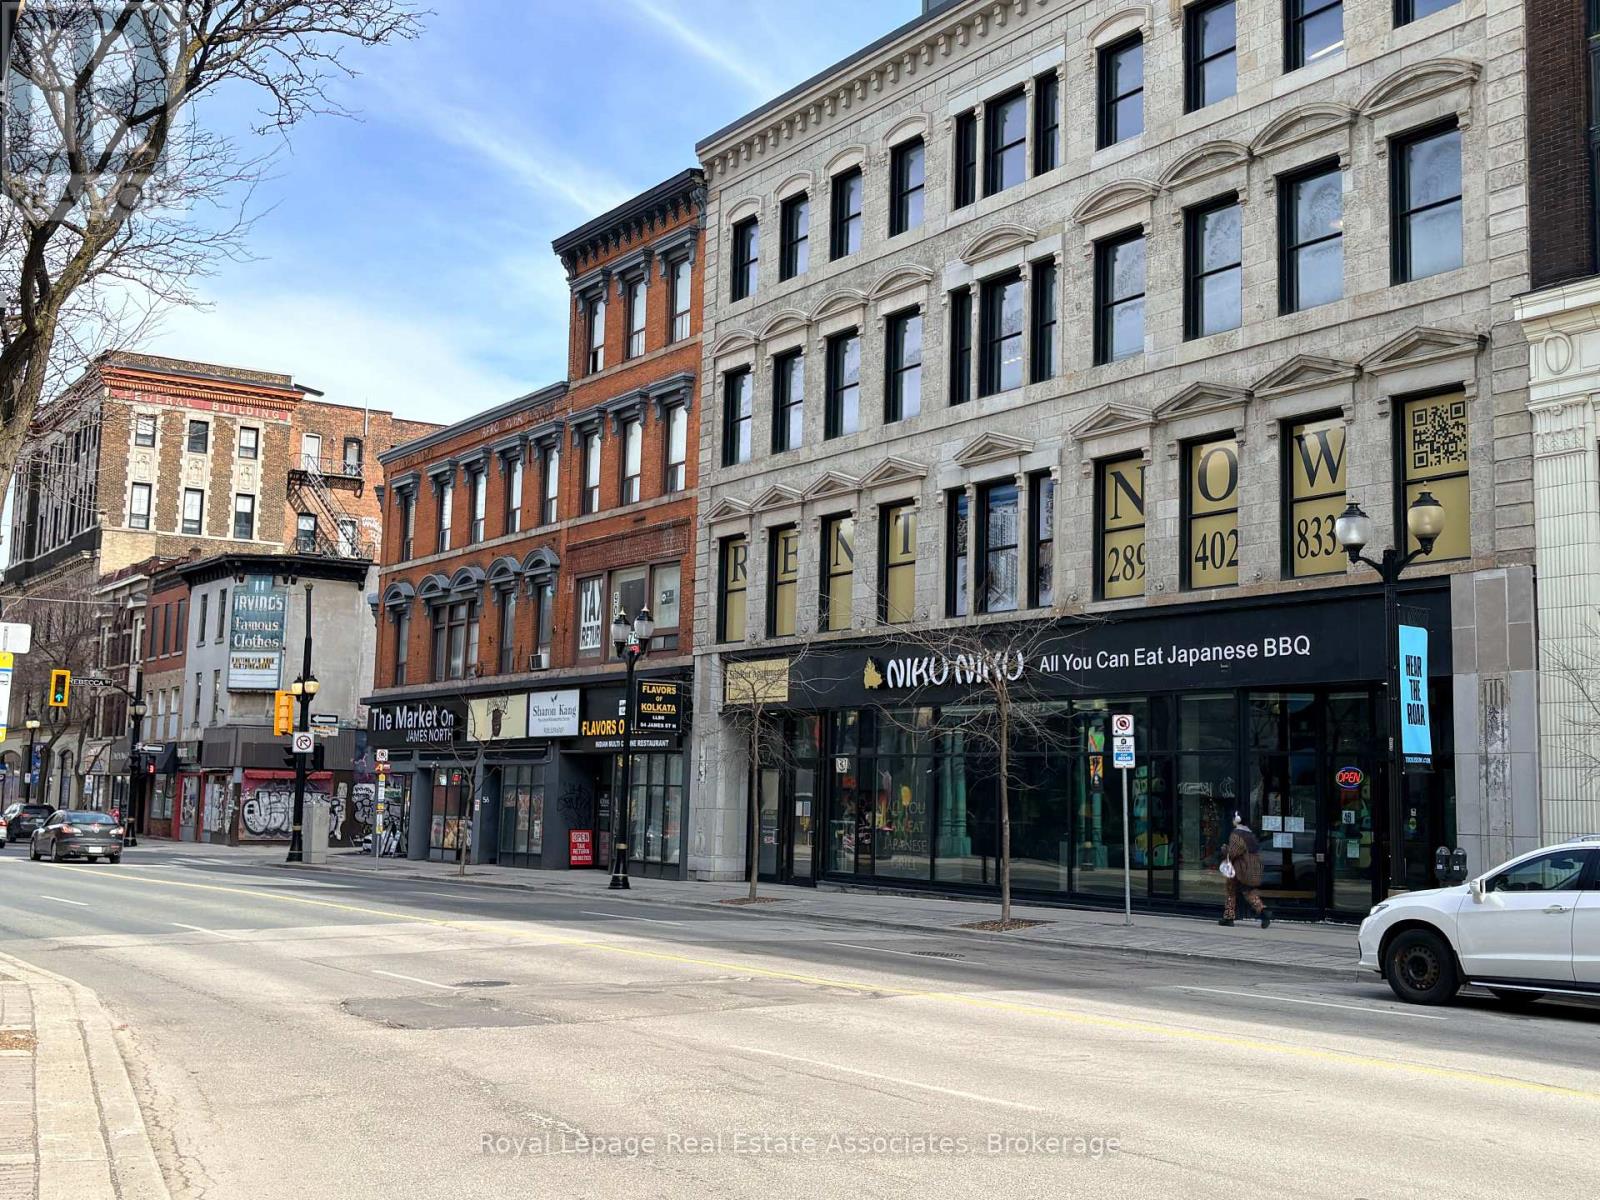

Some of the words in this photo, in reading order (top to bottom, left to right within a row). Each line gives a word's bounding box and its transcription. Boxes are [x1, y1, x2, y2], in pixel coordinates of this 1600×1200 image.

[212, 402, 281, 419] BUILDING
[1107, 543, 1146, 583] 289
[1194, 528, 1238, 571] 402
[1296, 514, 1345, 559] 833
[235, 616, 279, 631] Famous
[234, 633, 280, 648] Clothes
[886, 656, 949, 689] NIKU
[955, 649, 1024, 685] NIKU
[1040, 655, 1059, 672] All
[1062, 653, 1092, 671] You
[1096, 650, 1129, 668] Can
[1134, 648, 1163, 666] Eat
[1167, 643, 1259, 666] Japanese
[1263, 635, 1311, 657] BBQ
[1405, 655, 1422, 677] HEAR
[642, 685, 677, 695] FLAVORS
[1409, 679, 1421, 701] THE
[533, 705, 557, 717] Sharon
[559, 703, 577, 718] Kang
[641, 703, 676, 712] KOLKATA
[1407, 703, 1426, 726] ROAR
[372, 708, 392, 731] The
[396, 703, 437, 729] Market
[440, 709, 454, 727] On
[406, 729, 427, 742] JAMES
[428, 728, 454, 742] NORTH
[581, 720, 616, 736] FLAVORS
[1338, 771, 1361, 783] OPEN
[572, 833, 590, 841] OPEN
